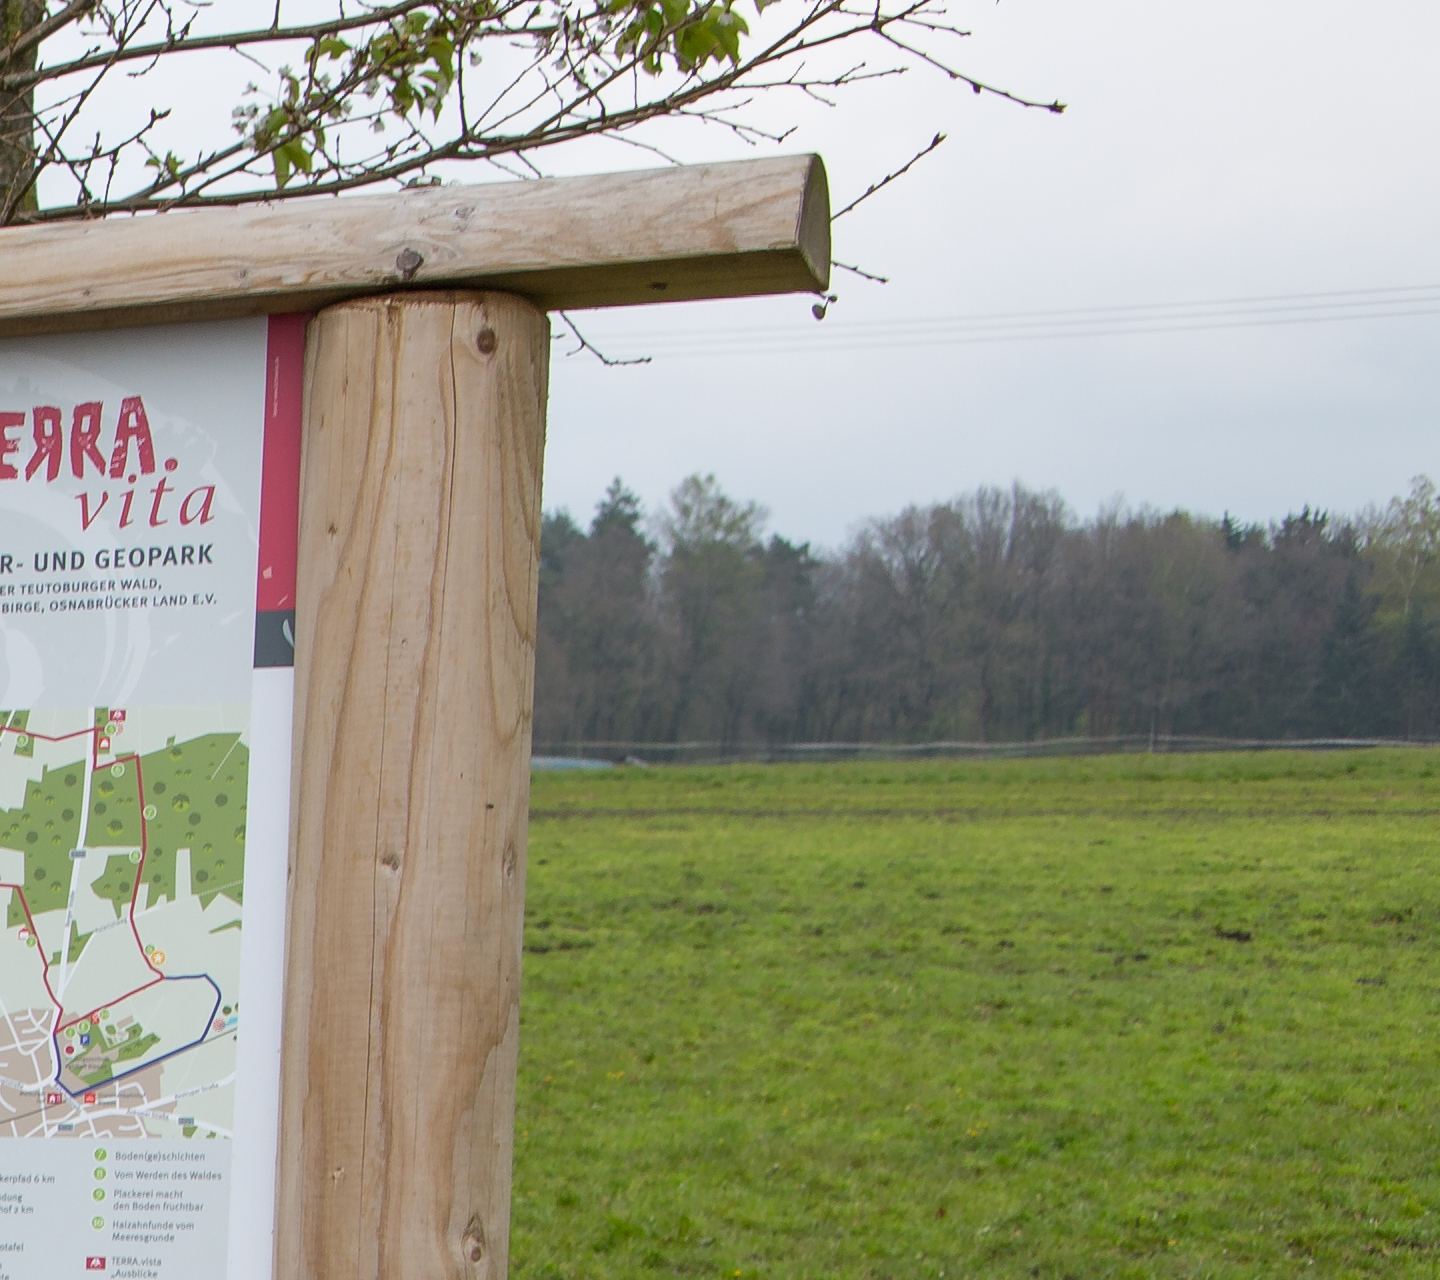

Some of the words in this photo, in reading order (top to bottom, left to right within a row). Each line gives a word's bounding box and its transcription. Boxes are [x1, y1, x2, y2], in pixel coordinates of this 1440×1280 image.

[74, 474, 216, 532] vita
[34, 551, 85, 573] UND
[95, 543, 213, 569] GEOPARK
[20, 579, 116, 595] TEUTOBURGER
[120, 578, 162, 591] WALD,
[49, 595, 148, 612] OSNABRÜCKER
[153, 595, 188, 607] LAND
[192, 593, 217, 606] E.V.
